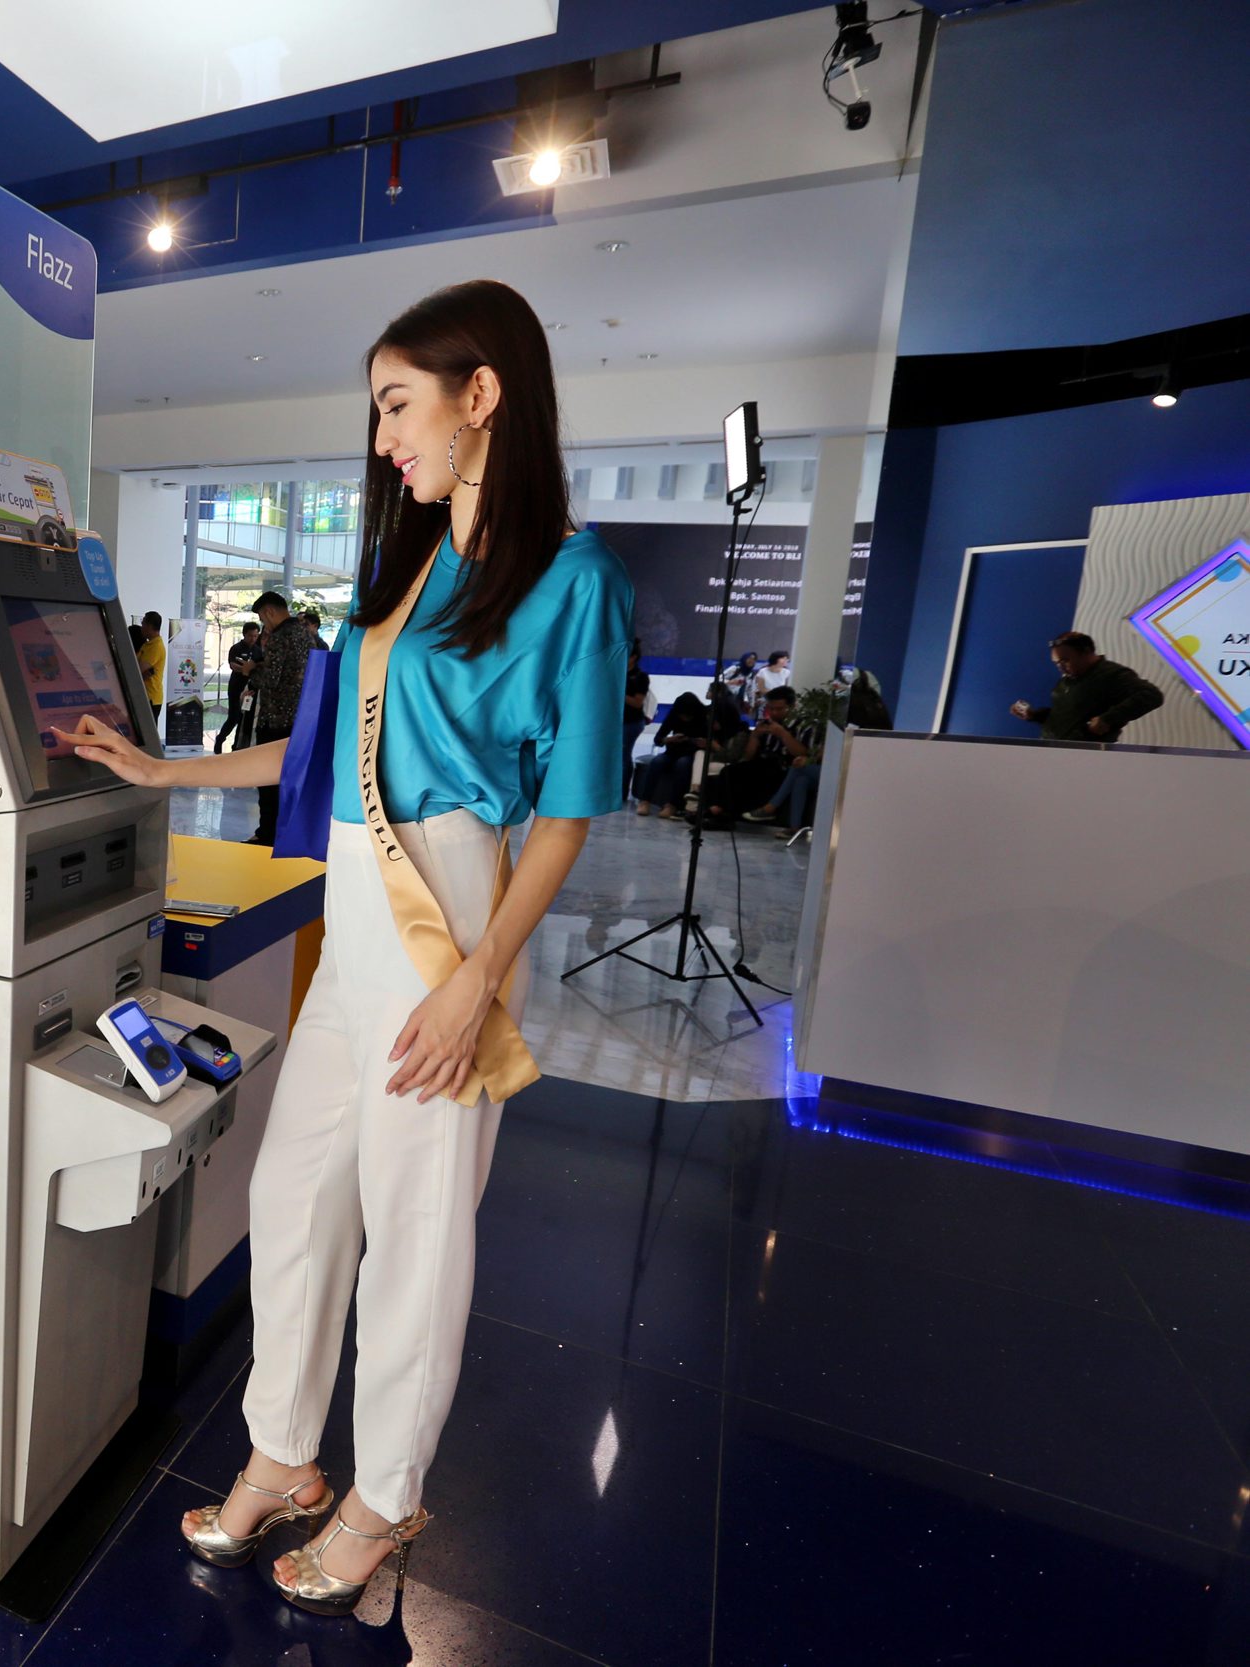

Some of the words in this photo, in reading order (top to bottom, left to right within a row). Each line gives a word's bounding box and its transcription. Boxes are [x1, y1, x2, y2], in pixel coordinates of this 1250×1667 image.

[27, 233, 73, 290] Flazz
[8, 493, 34, 510] Cepat
[771, 552, 784, 560] TO
[731, 577, 752, 588] ahja
[751, 592, 786, 601] Santoso
[747, 605, 773, 615] Grand
[361, 693, 404, 863] BENGKULU
